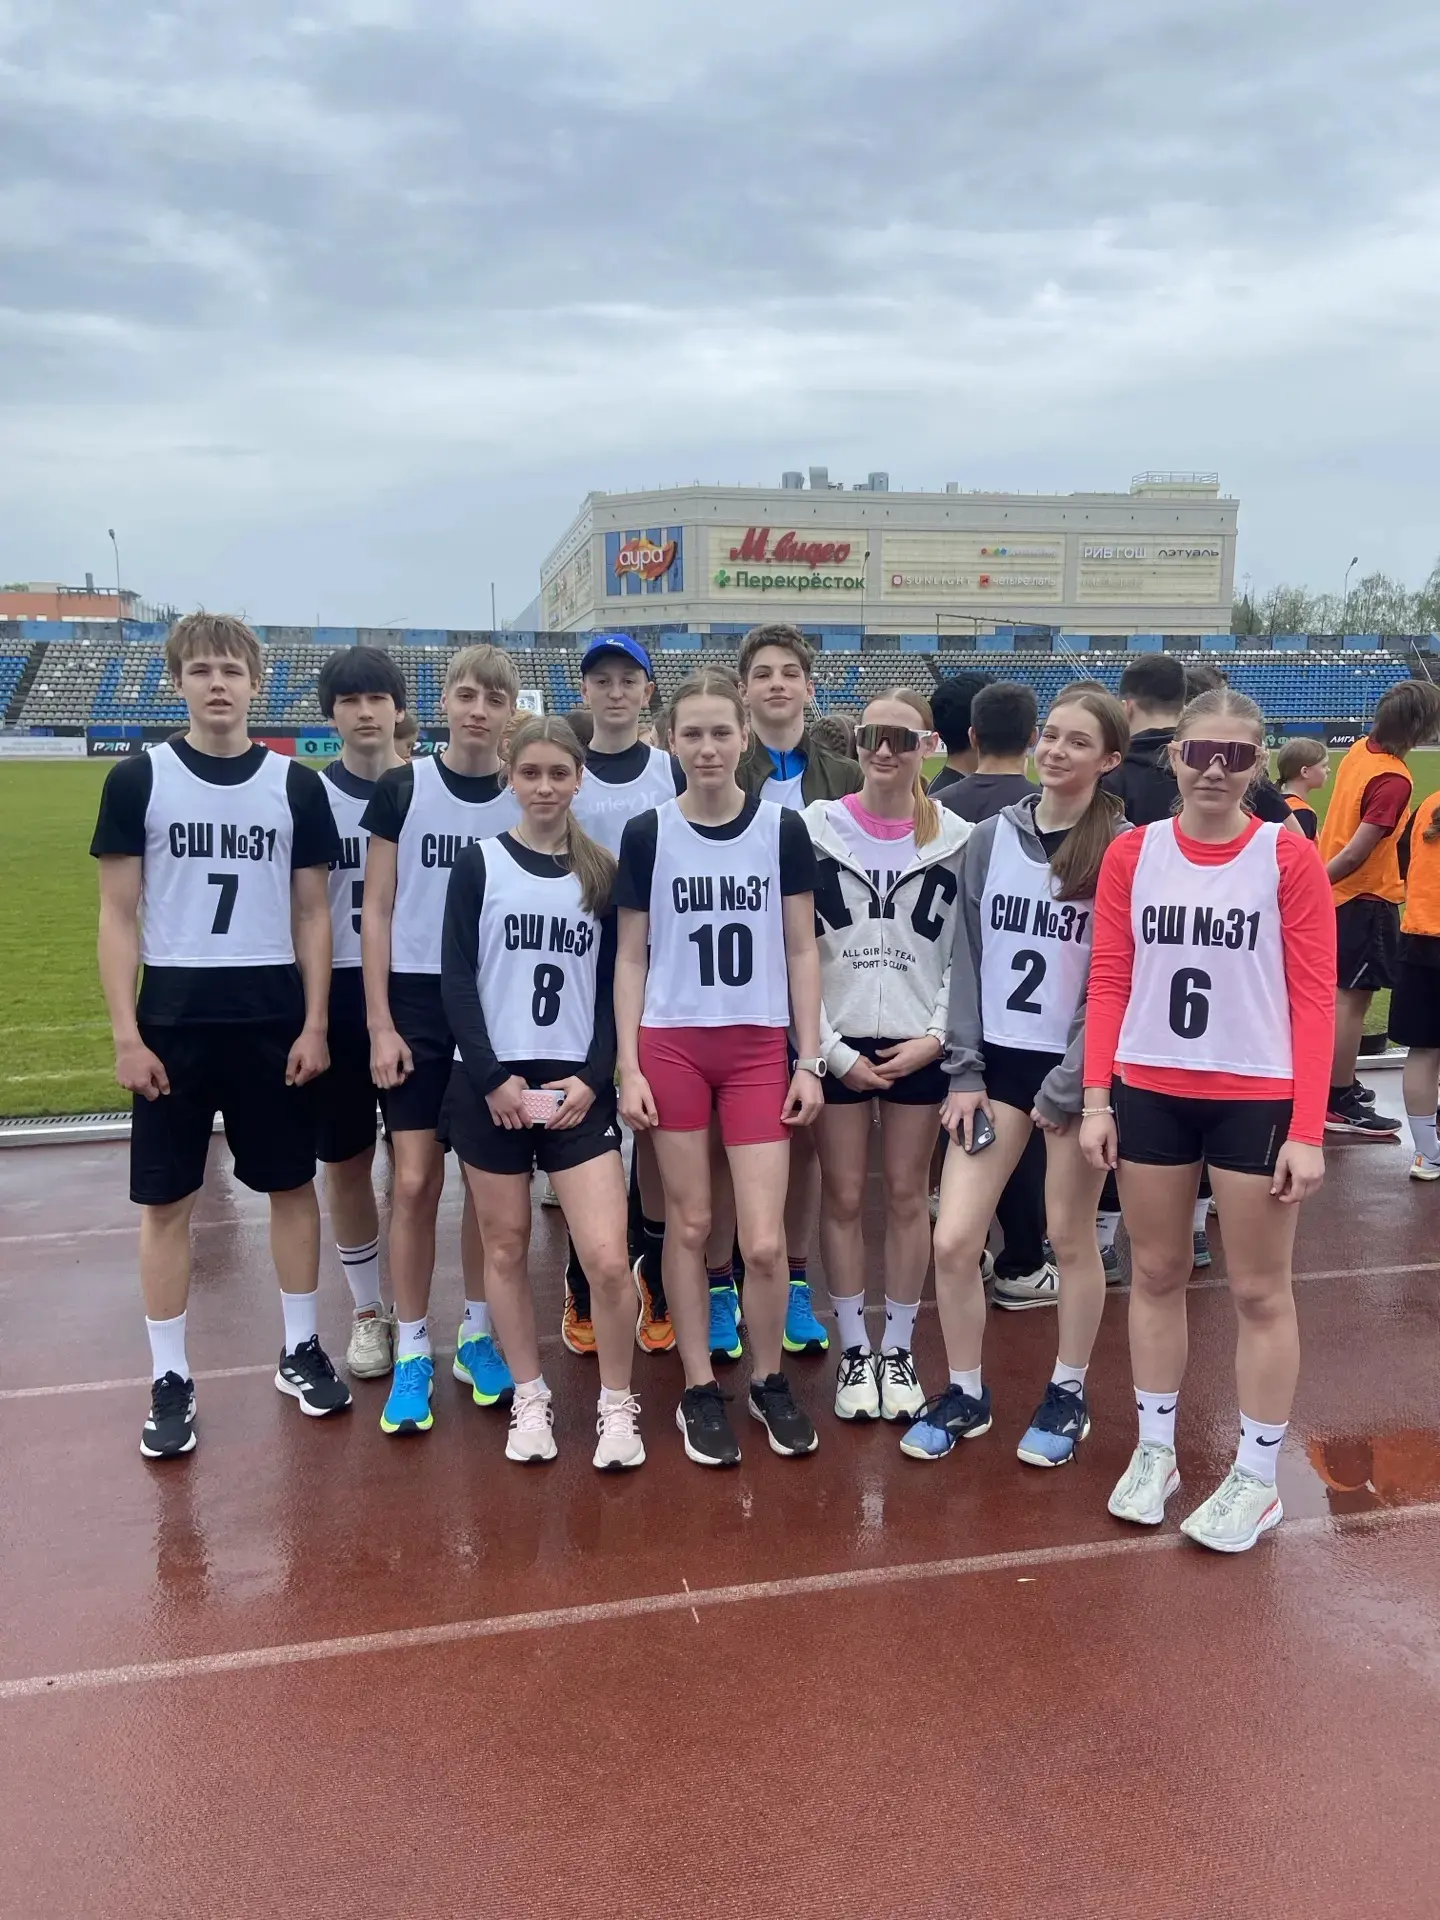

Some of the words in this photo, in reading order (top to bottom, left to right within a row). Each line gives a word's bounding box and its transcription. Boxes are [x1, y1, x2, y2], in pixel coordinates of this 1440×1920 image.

[620, 549, 664, 571] аура
[1116, 546, 1146, 559] ГОШ
[736, 571, 866, 592] Перекрёсток
[906, 576, 973, 586] SUNLIGHT
[93, 742, 131, 752] PARI
[169, 822, 213, 859] СШ
[221, 824, 277, 862] №31
[207, 873, 239, 935] 7
[672, 876, 714, 914] СШ
[720, 875, 770, 912] №31
[504, 913, 545, 951] СШ
[991, 893, 1030, 933] СШ
[1032, 900, 1090, 945] №31
[1142, 905, 1187, 945] СШ
[1192, 906, 1261, 951] №31
[688, 922, 754, 987] 10
[842, 949, 860, 958] ALL
[852, 958, 888, 970] SPORTS
[889, 960, 909, 972] CLUB
[531, 962, 565, 1027] 8
[1006, 949, 1047, 1015] 2
[1169, 967, 1212, 1040] 6
